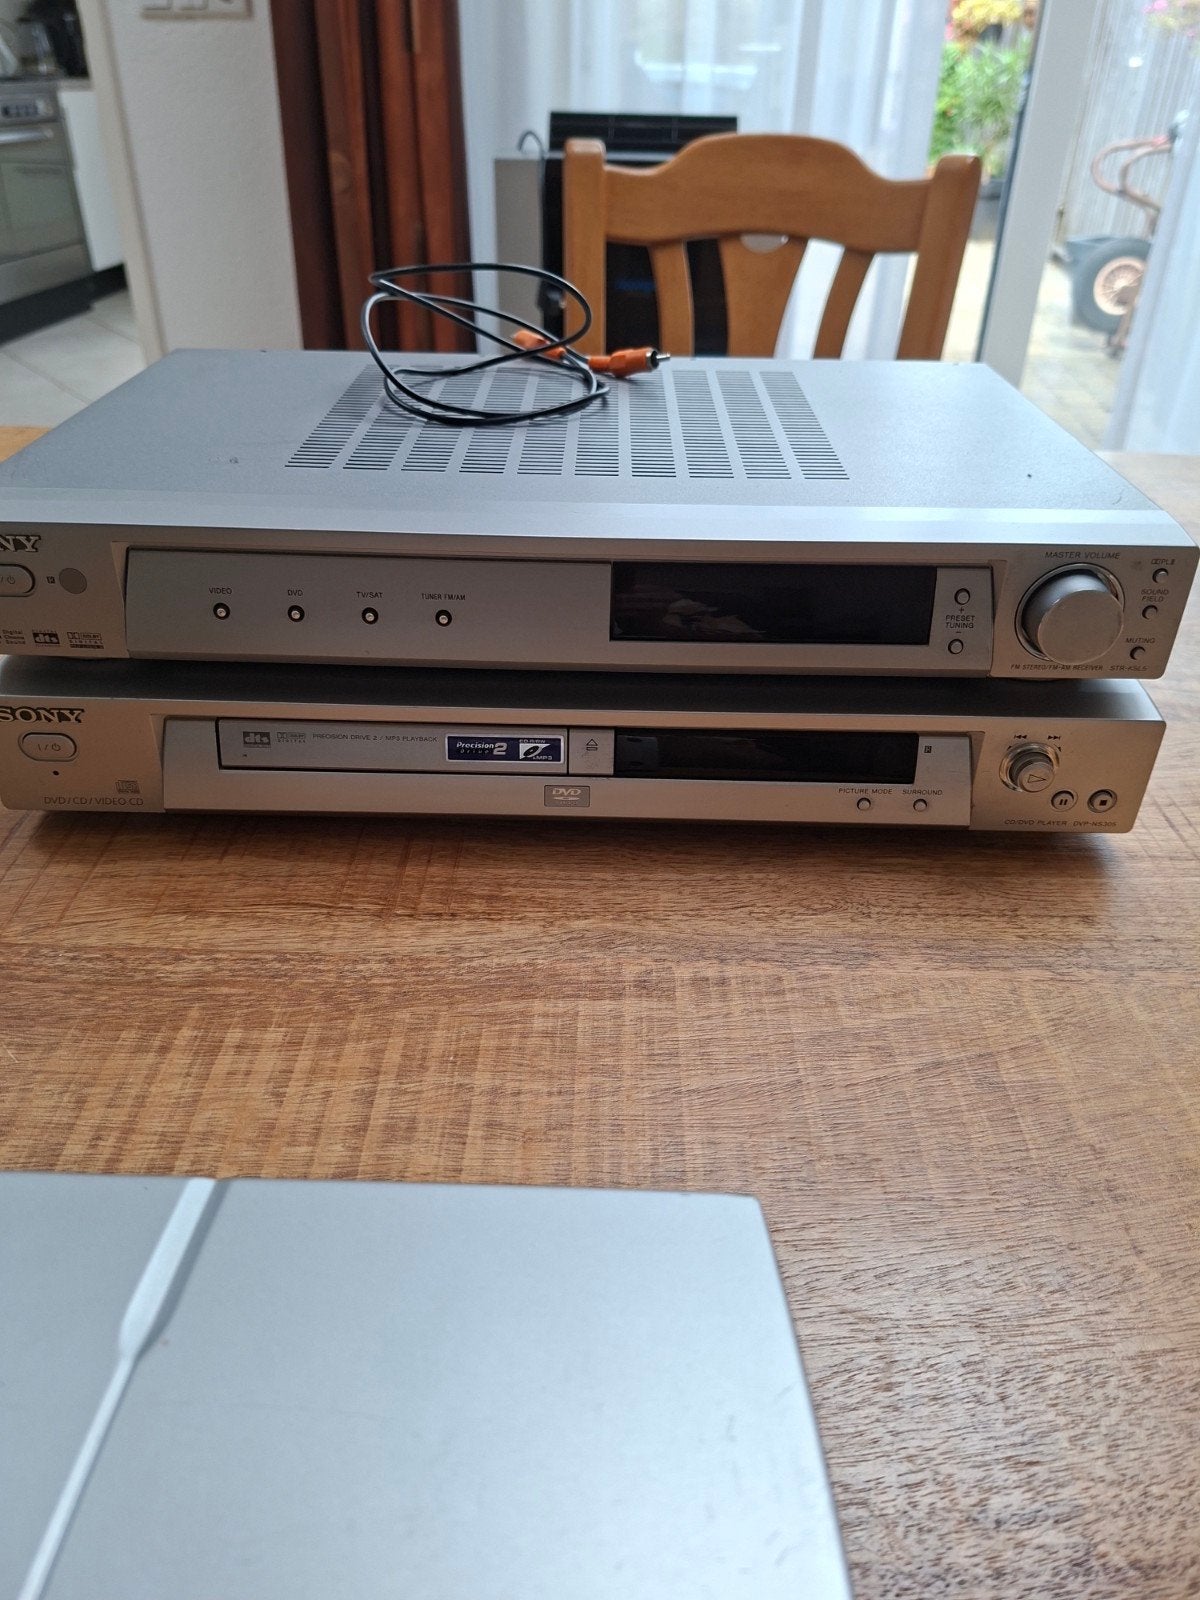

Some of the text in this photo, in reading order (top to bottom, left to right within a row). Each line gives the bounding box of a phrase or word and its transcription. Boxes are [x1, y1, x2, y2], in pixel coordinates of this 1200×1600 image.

[1045, 551, 1080, 559] MASTER
[209, 587, 232, 595] VIDEO
[444, 593, 466, 601] FM/AM
[0, 706, 84, 723] SONY
[493, 742, 508, 755] 2
[552, 787, 581, 796] DVD
[128, 797, 144, 806] CD
